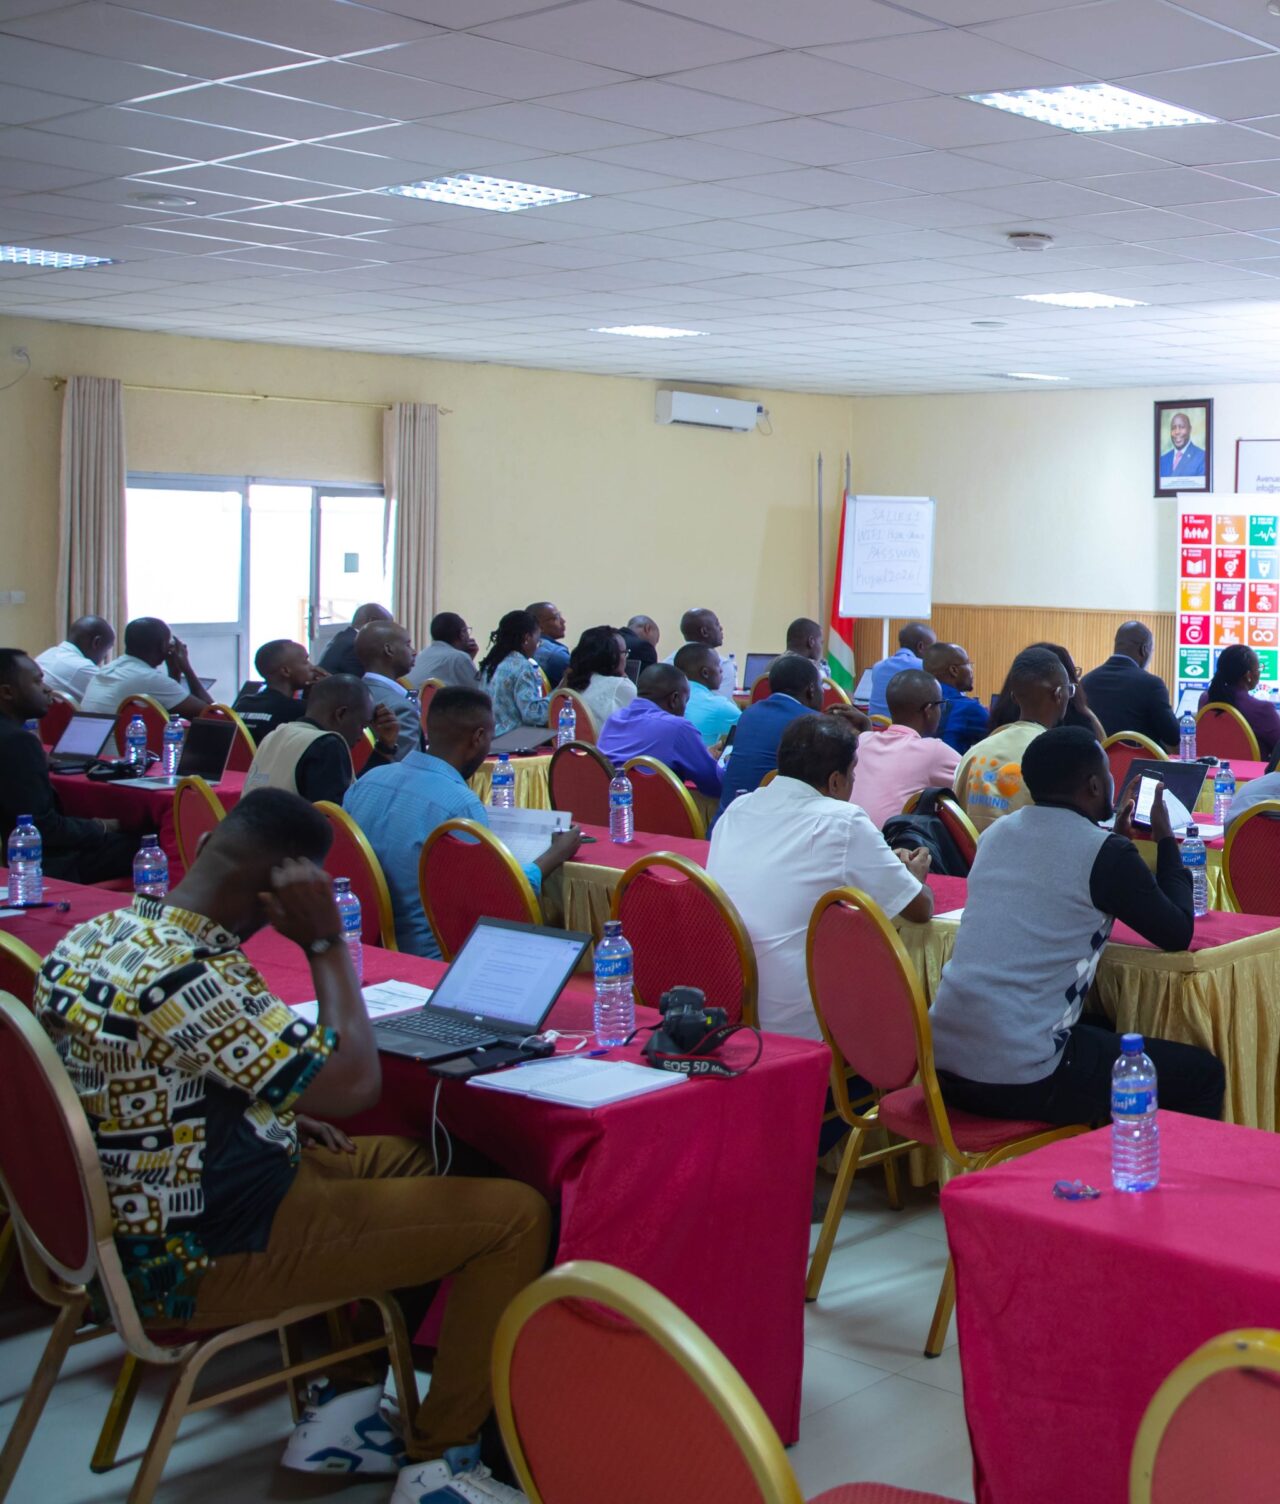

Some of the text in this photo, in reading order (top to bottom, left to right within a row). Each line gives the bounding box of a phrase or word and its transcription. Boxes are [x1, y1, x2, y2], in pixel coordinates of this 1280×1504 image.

[595, 961, 622, 974] Kinju
[663, 1060, 690, 1072] EOS
[692, 1061, 710, 1073] 5D
[1112, 1096, 1137, 1110] inju
